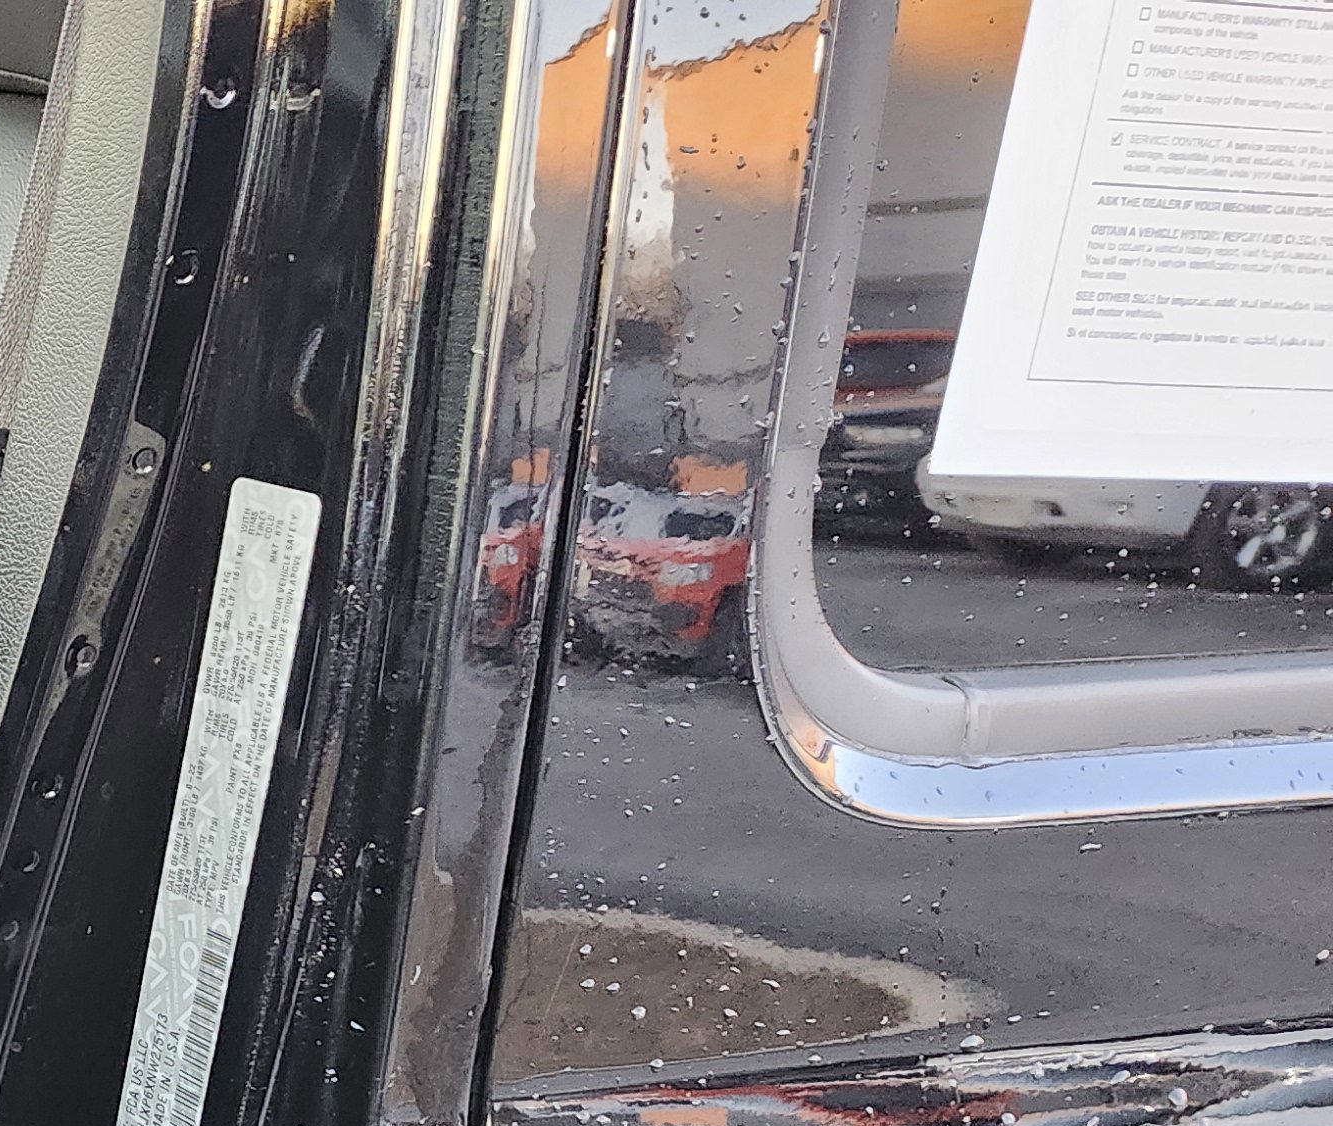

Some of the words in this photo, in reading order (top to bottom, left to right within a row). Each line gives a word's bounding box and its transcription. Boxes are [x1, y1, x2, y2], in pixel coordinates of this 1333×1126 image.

[285, 513, 299, 551] SAFETY
[277, 553, 292, 593] VEHICLE
[270, 596, 284, 630] MOTOR
[281, 587, 295, 624] SHOWN
[261, 632, 277, 675] FEDERAL
[267, 626, 288, 698] MANUFACTURE
[264, 700, 273, 714] OF
[244, 709, 262, 767] APPLICABLE
[258, 716, 270, 741] DATE
[255, 742, 265, 761] THE
[240, 768, 250, 786] ALL
[251, 763, 261, 778] ON
[237, 787, 247, 800] TO
[244, 780, 258, 814] EFFECT
[227, 801, 244, 853] CONFORMS
[242, 815, 251, 827] IN
[170, 853, 179, 867] OF
[231, 828, 248, 884] STANDARDS
[165, 868, 176, 892] DATE
[220, 854, 233, 891] VEHICLE
[216, 893, 226, 914] THIS
[135, 1037, 149, 1064] LLC
[164, 1024, 181, 1068] U.S.A.
[130, 1065, 143, 1086] US
[125, 1088, 139, 1116] FCA
